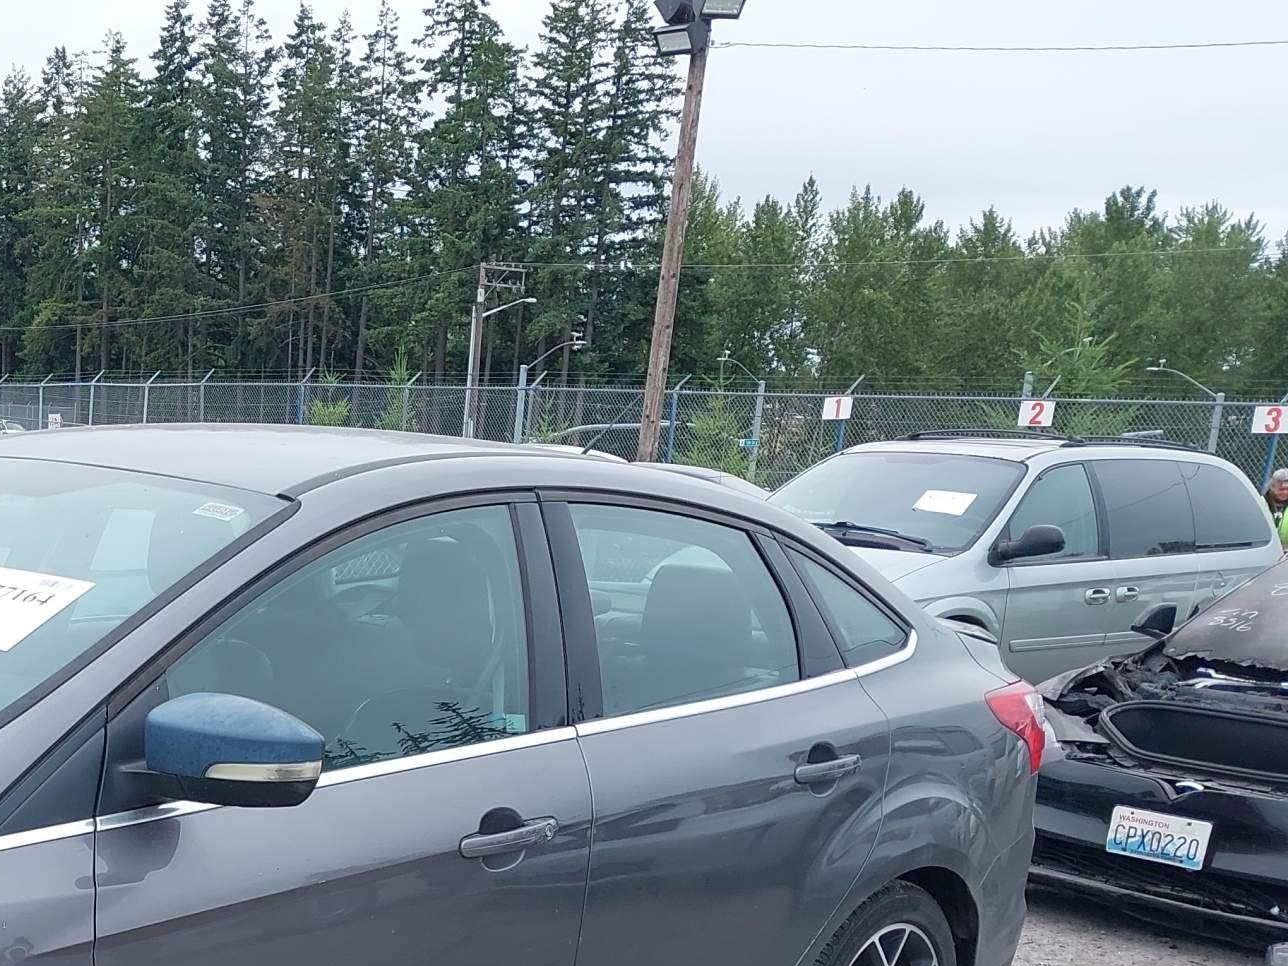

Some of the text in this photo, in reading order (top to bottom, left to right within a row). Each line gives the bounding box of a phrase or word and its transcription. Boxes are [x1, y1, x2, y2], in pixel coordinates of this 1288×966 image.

[835, 398, 841, 418] 1
[1029, 402, 1044, 424] 2
[1265, 407, 1282, 432] 3
[1119, 814, 1170, 829] WASHINGTON
[1113, 824, 1200, 861] CPX0220
